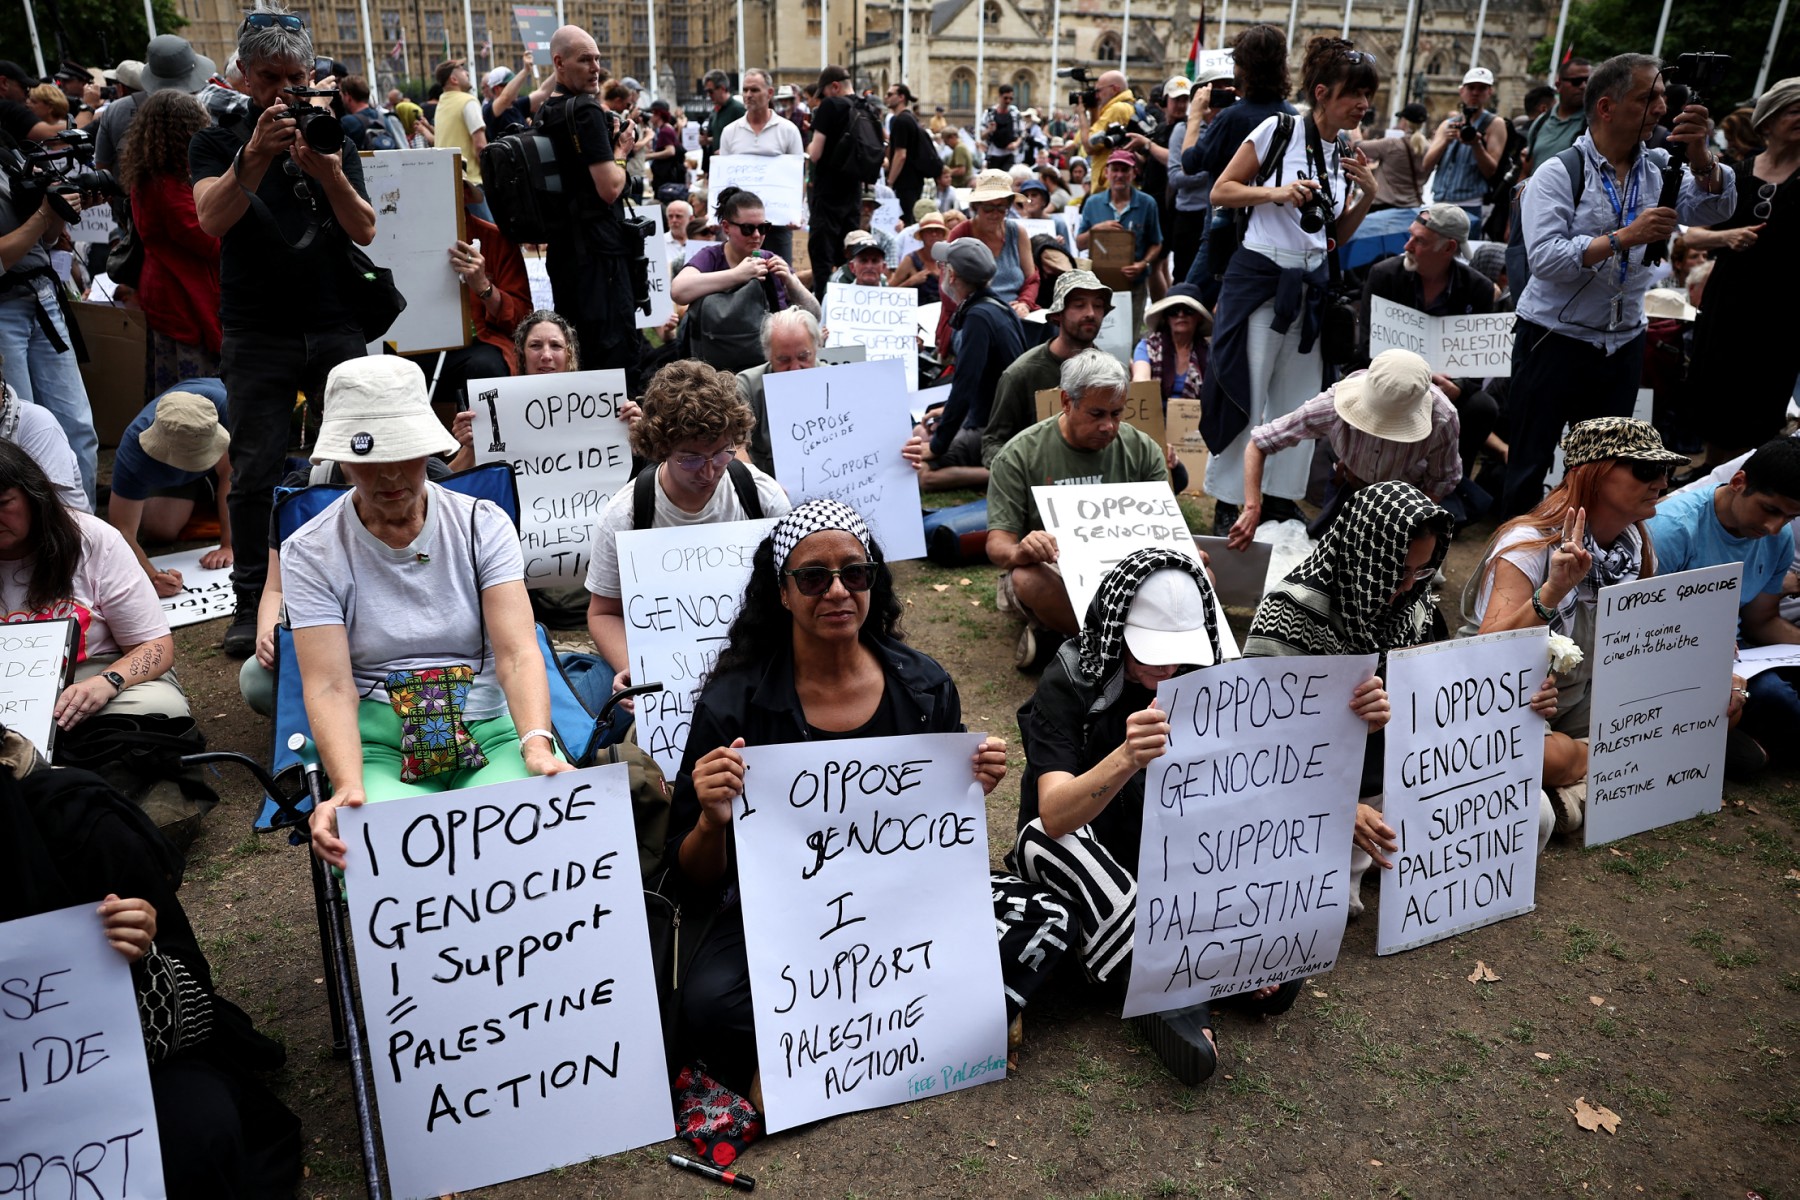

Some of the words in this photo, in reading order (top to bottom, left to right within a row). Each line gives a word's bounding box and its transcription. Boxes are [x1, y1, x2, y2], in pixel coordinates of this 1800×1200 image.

[829, 306, 911, 325] GENOCIDE
[837, 287, 847, 303] I
[854, 290, 917, 307] OPPOSE
[1374, 300, 1378, 313] I
[1385, 306, 1426, 330] OPPOSE
[833, 330, 844, 346] I
[852, 334, 917, 352] SUPPORT
[1370, 322, 1427, 355] GENOCIDE
[1441, 319, 1445, 335] I
[1442, 333, 1515, 352] PALESTIN
[826, 382, 829, 410] I
[478, 387, 506, 453] I
[524, 391, 625, 431] OPPOSE
[791, 411, 851, 441] OPPOSE
[802, 423, 855, 456] GENOCIDE
[512, 444, 624, 477] ENOCIDE
[801, 466, 805, 492] I
[818, 450, 880, 484] SUPPORT
[1046, 497, 1060, 528] I
[1077, 496, 1183, 520] OPPOSE
[1073, 523, 1190, 543] GENOCIDE
[630, 551, 638, 583] I
[661, 543, 758, 573] OPPOSE
[628, 593, 734, 632] GENOC
[1607, 597, 1612, 617] I
[1617, 588, 1667, 611] OPPOSE
[1676, 577, 1738, 601] GENOCIDE
[1167, 687, 1180, 747] I
[1192, 672, 1329, 738] OPPOSE
[1411, 691, 1416, 735] I
[1435, 667, 1533, 729] OPPOSE
[1593, 726, 1664, 757] PALESTINE
[1671, 714, 1720, 737] ACTION
[1598, 722, 1602, 741] I
[1609, 706, 1663, 735] SUPPORT
[1401, 724, 1525, 789] GENOCIDE
[788, 758, 934, 814] OPPOSE
[1160, 742, 1331, 817] GENOCIDE
[1594, 777, 1656, 806] PALESTINE
[1666, 763, 1711, 788] ACTION
[362, 821, 379, 877] I
[401, 783, 597, 876] OPPOSE
[1401, 818, 1406, 853] I
[1428, 777, 1534, 842] SUPPORT
[1163, 835, 1168, 882] I
[1192, 813, 1331, 875] SUPPORT
[1399, 819, 1530, 889] PALESTINE
[368, 850, 619, 951] GENOCIDE
[818, 891, 867, 940] I
[1148, 869, 1339, 945] PALESTINE
[1401, 862, 1515, 934] ACTION
[390, 961, 400, 997] I
[774, 939, 934, 1015] SUPPORT
[1164, 929, 1318, 992] ACTION.
[1210, 983, 1236, 998] THIS
[1239, 979, 1252, 992] IS
[387, 977, 616, 1084] PALESTINE
[426, 1041, 622, 1133] ACTION
